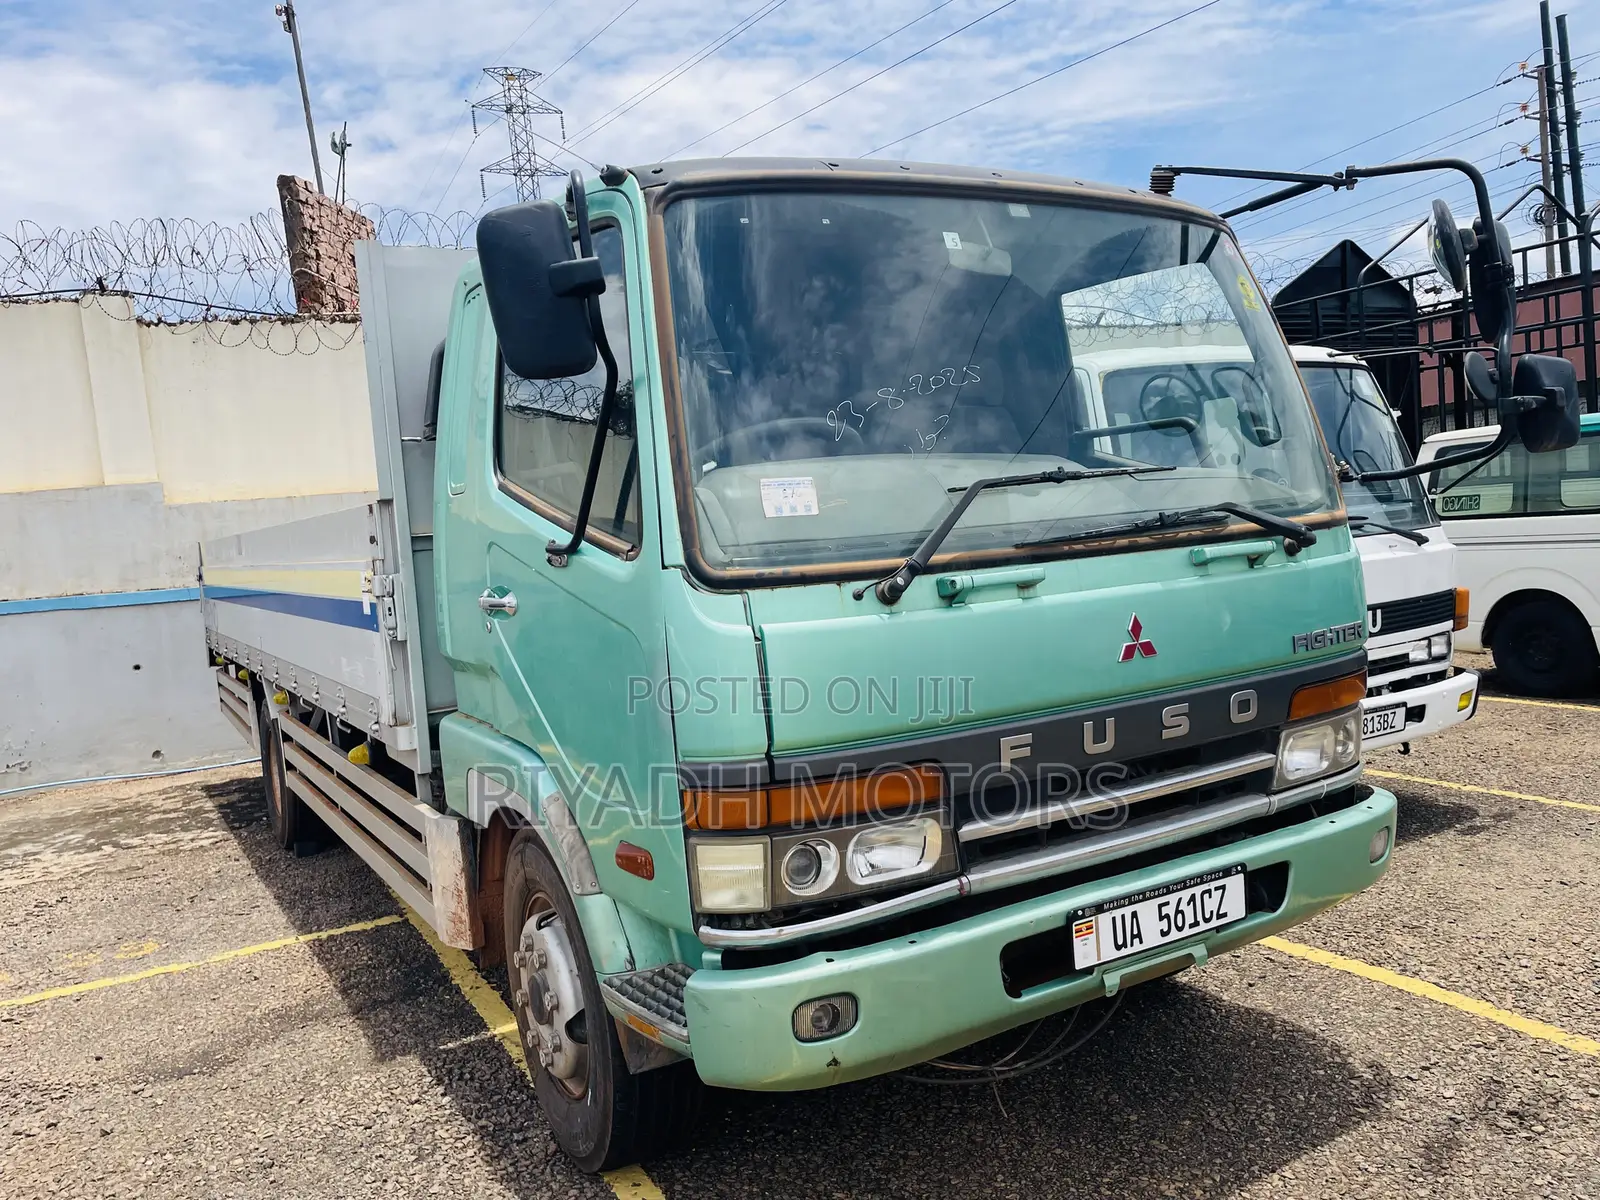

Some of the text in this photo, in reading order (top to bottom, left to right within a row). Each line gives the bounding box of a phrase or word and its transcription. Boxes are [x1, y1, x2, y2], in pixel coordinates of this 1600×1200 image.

[1292, 620, 1363, 654] FIGHTER
[1000, 689, 1258, 774] FUSO
[1362, 711, 1397, 735] 813BZ
[1103, 871, 1224, 910] Making the Roads Your Safe Space
[1111, 884, 1228, 951] UA 561CZ
